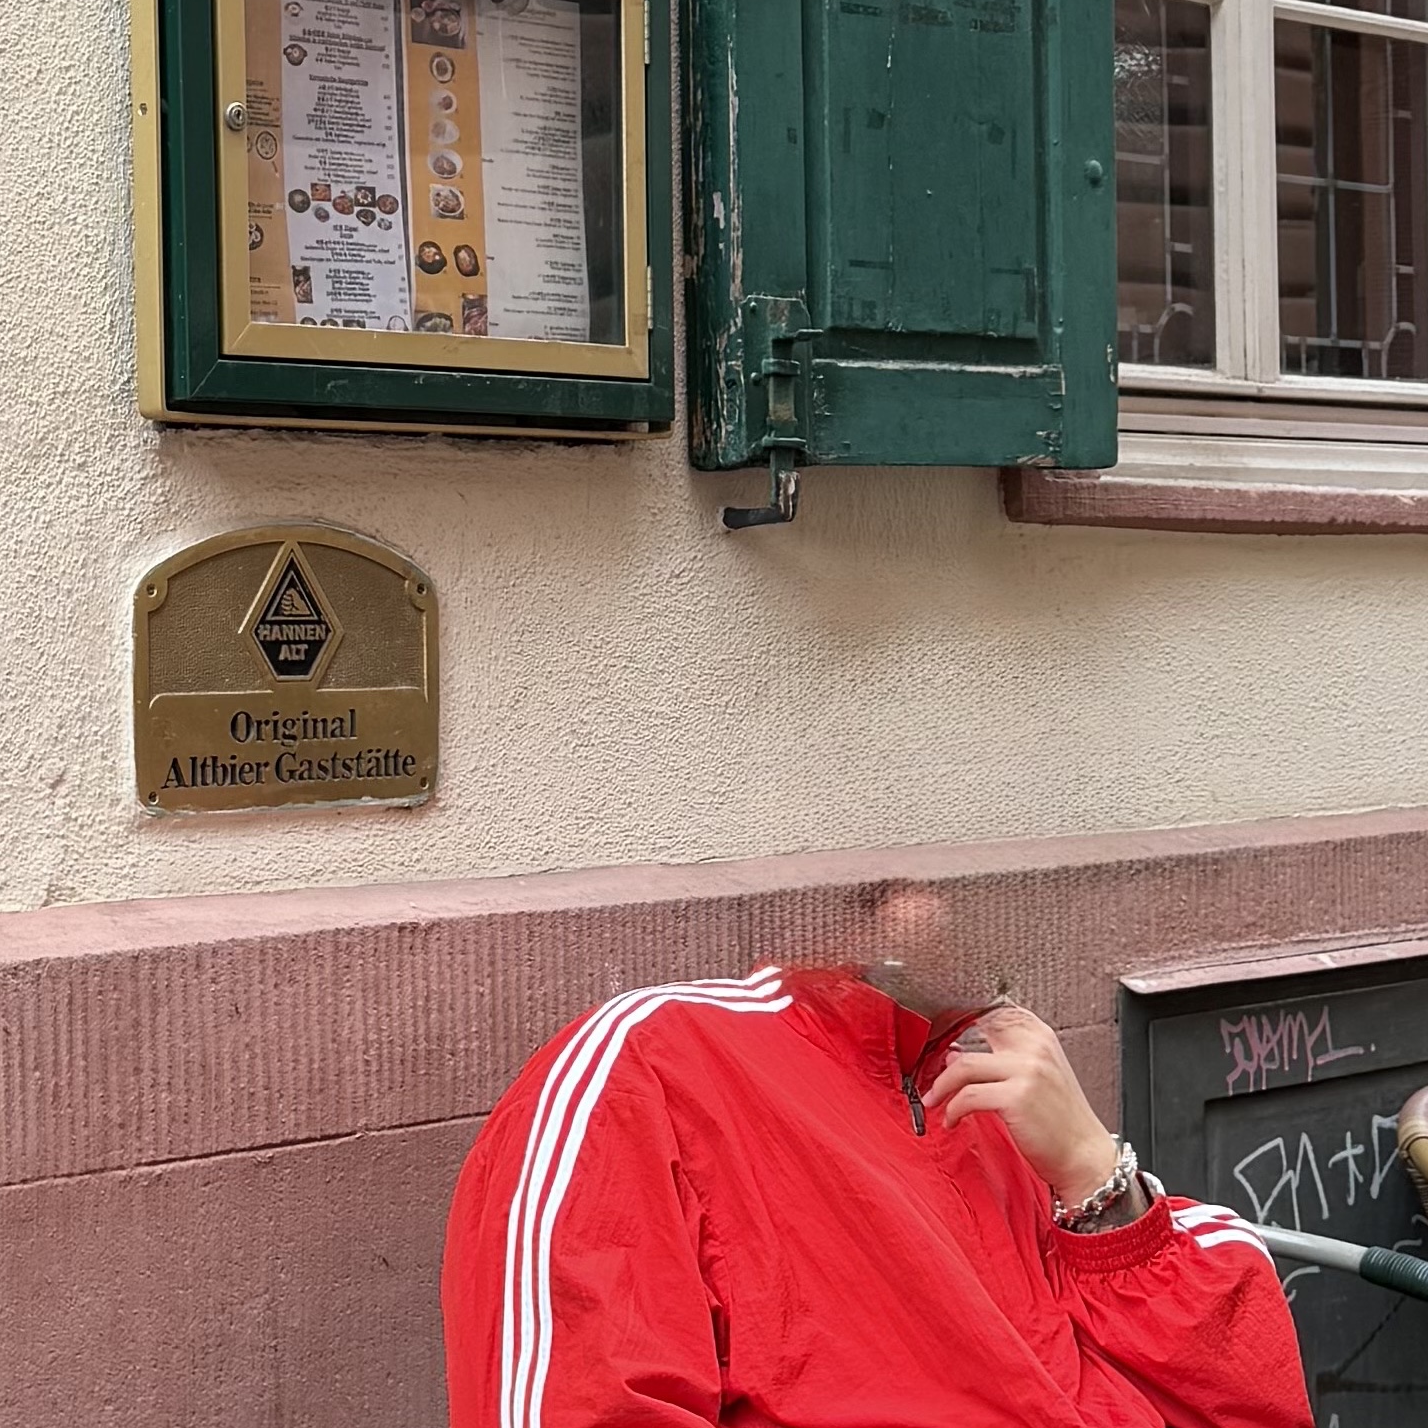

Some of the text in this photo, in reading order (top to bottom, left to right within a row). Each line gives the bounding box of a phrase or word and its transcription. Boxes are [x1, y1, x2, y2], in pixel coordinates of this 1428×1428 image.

[257, 623, 327, 642] HANNEN
[278, 643, 309, 662] ALT
[230, 708, 358, 748] Original
[160, 747, 417, 790] Altbier Gaststätte
